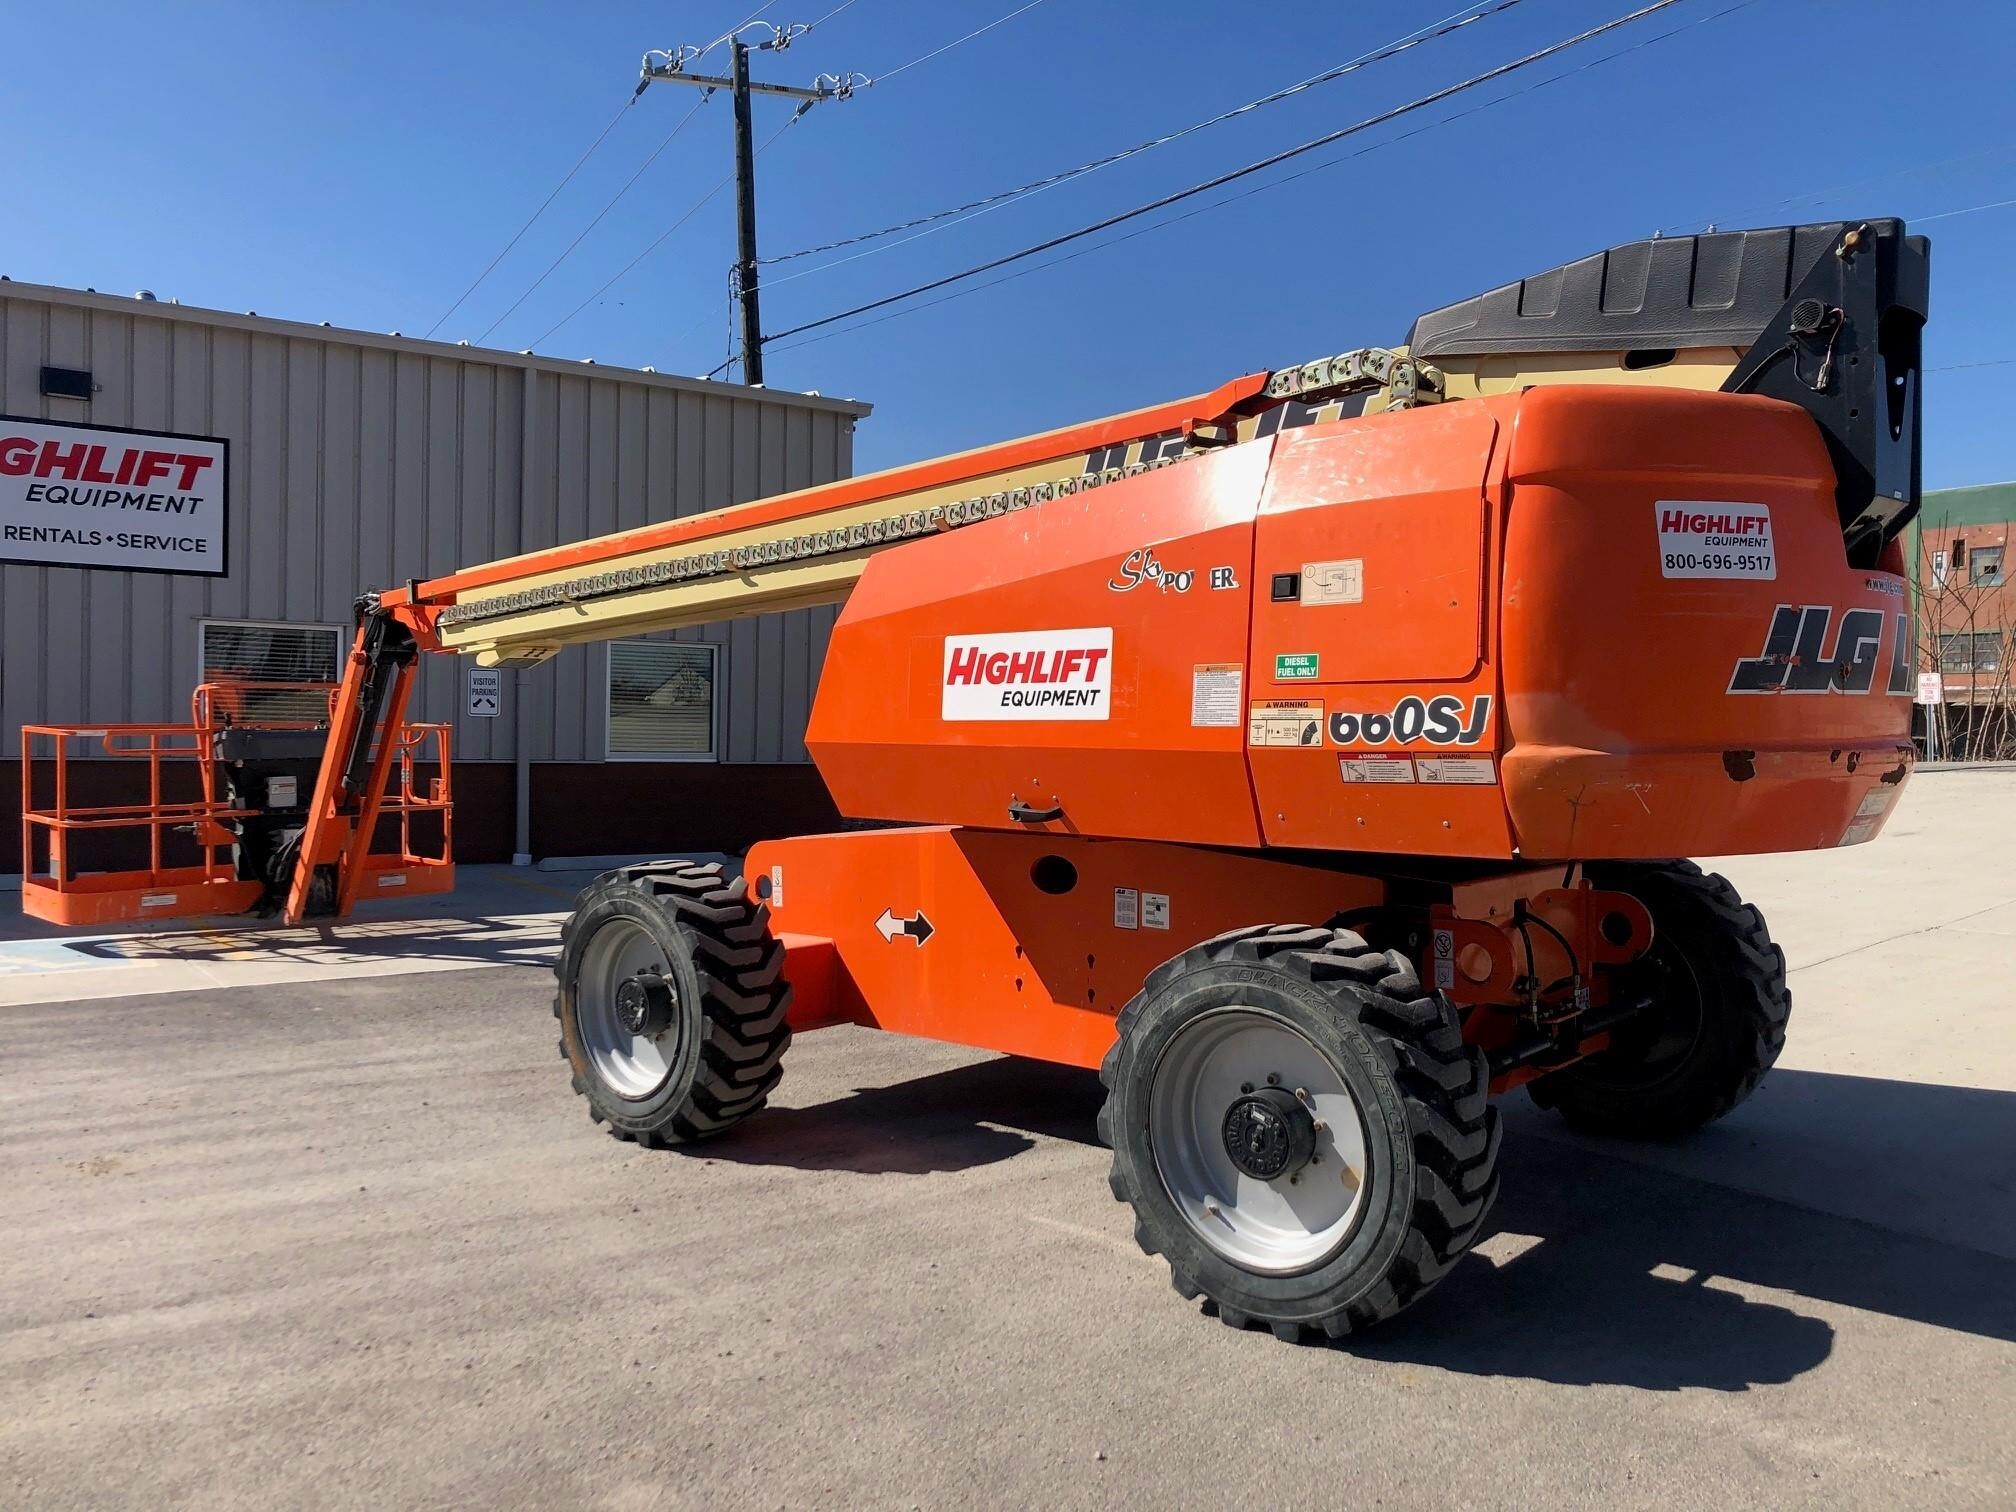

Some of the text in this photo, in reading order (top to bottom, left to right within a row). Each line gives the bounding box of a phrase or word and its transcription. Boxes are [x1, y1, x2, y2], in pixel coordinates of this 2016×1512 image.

[0, 437, 214, 490] GHLIFT
[25, 483, 204, 515] EQUIPMENT
[1660, 510, 1769, 535] HIGHLIFT
[4, 525, 207, 553] RENTALS SERVICE
[1704, 536, 1768, 548] EQUIPMENT
[1665, 553, 1771, 572] 800-696-9517
[1725, 604, 1885, 695] JLG
[946, 646, 1109, 686] HIGHLIFT
[1284, 657, 1310, 666] DIESEL
[1277, 666, 1316, 677] FUEL ONLY
[472, 677, 497, 685] VISITOR
[471, 688, 497, 696] PARKING
[1000, 689, 1100, 707] EQUIPMENT
[1272, 701, 1309, 709] WARNING
